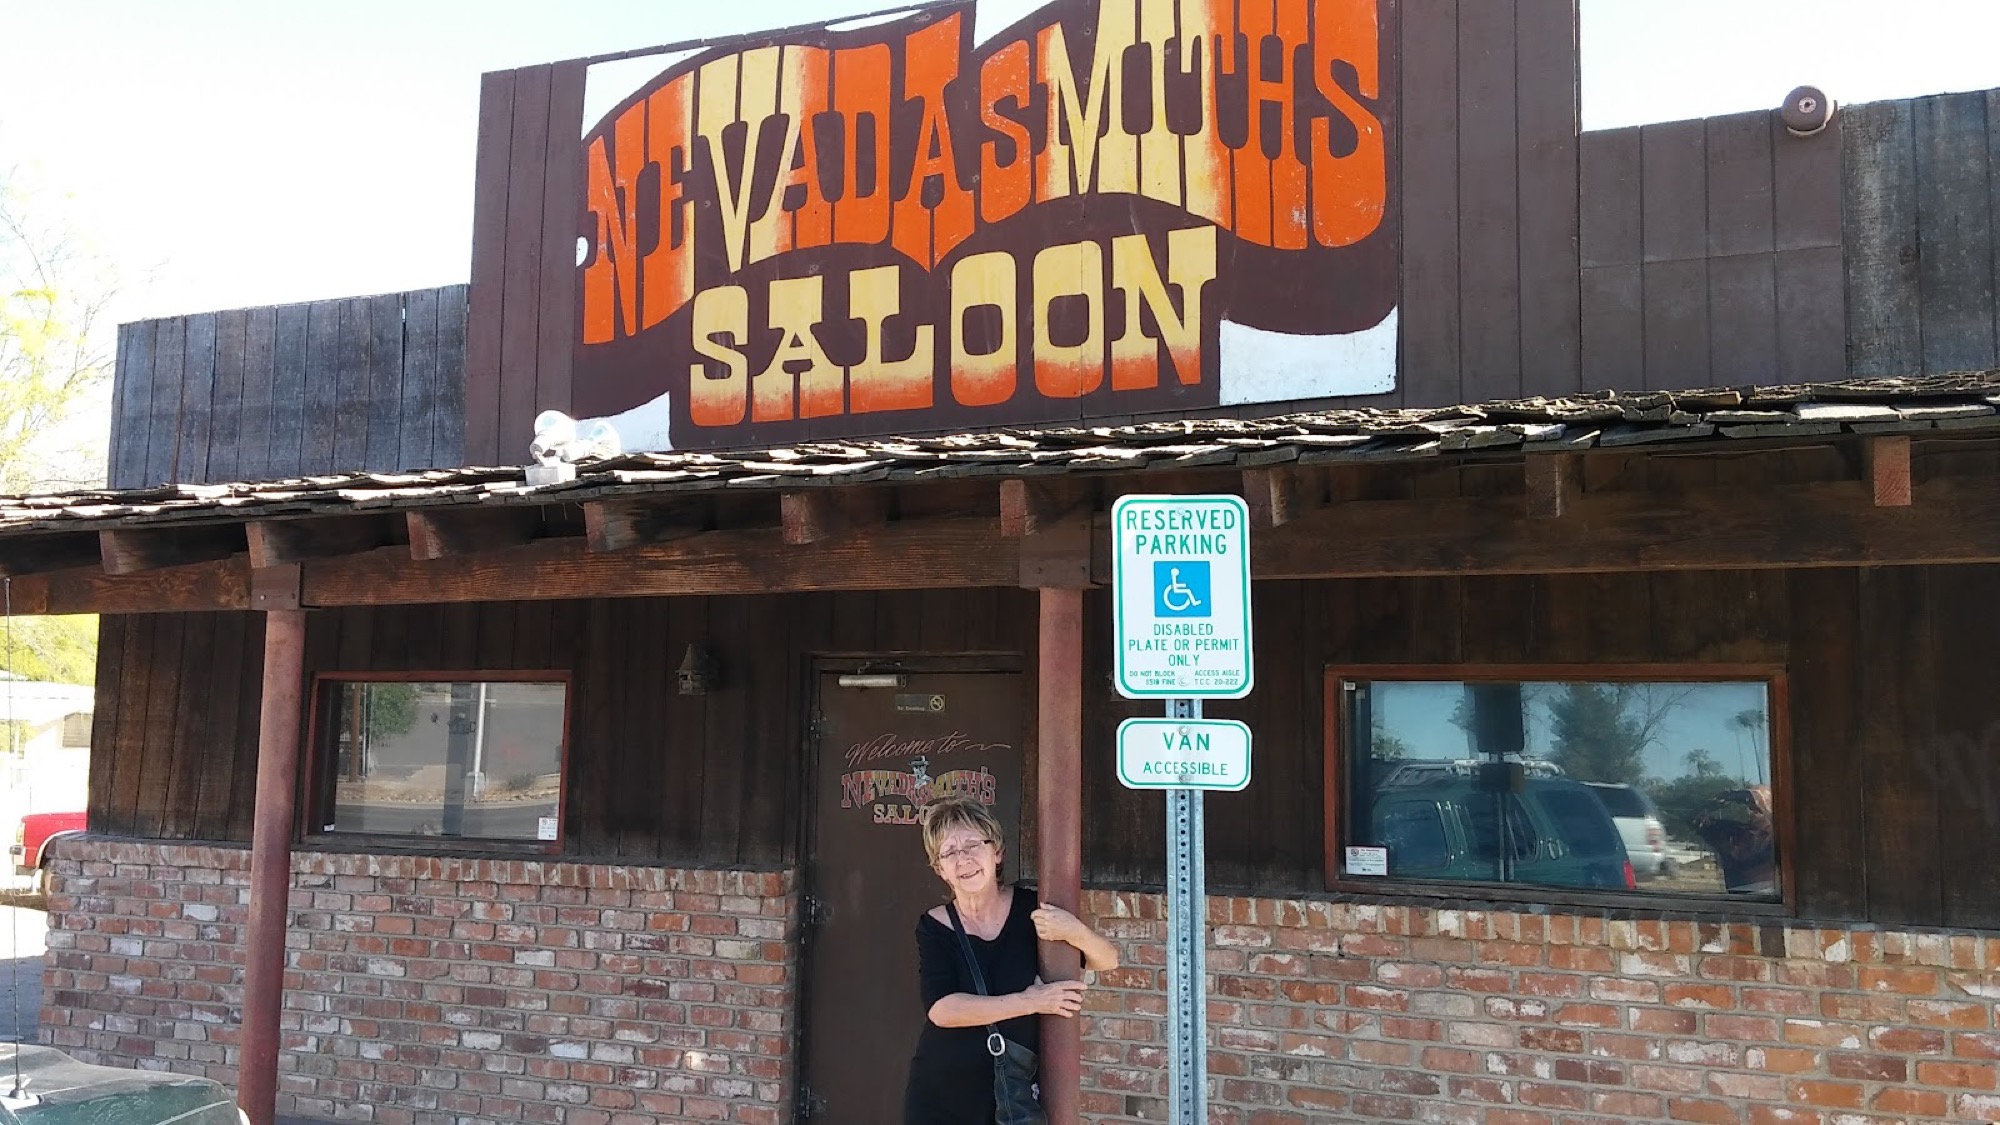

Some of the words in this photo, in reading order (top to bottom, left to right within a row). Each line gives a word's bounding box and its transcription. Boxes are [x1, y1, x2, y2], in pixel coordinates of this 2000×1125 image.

[690, 225, 1217, 428] SALOON
[1126, 509, 1235, 531] RESERVED
[1136, 534, 1227, 555] PARKING
[1153, 623, 1214, 636] DISABLED
[1128, 638, 1167, 651] PLATE
[1174, 638, 1190, 651] OR
[1195, 637, 1240, 651] PERMIT
[1168, 654, 1200, 667] ONLY
[1194, 669, 1220, 677] ACCESS
[1222, 669, 1240, 677] AISLE
[1161, 678, 1176, 686] FINE
[845, 733, 932, 768] Welcome
[936, 730, 970, 754] to
[1163, 732, 1210, 751] VAN
[1143, 761, 1229, 776] ACCESSIBLE
